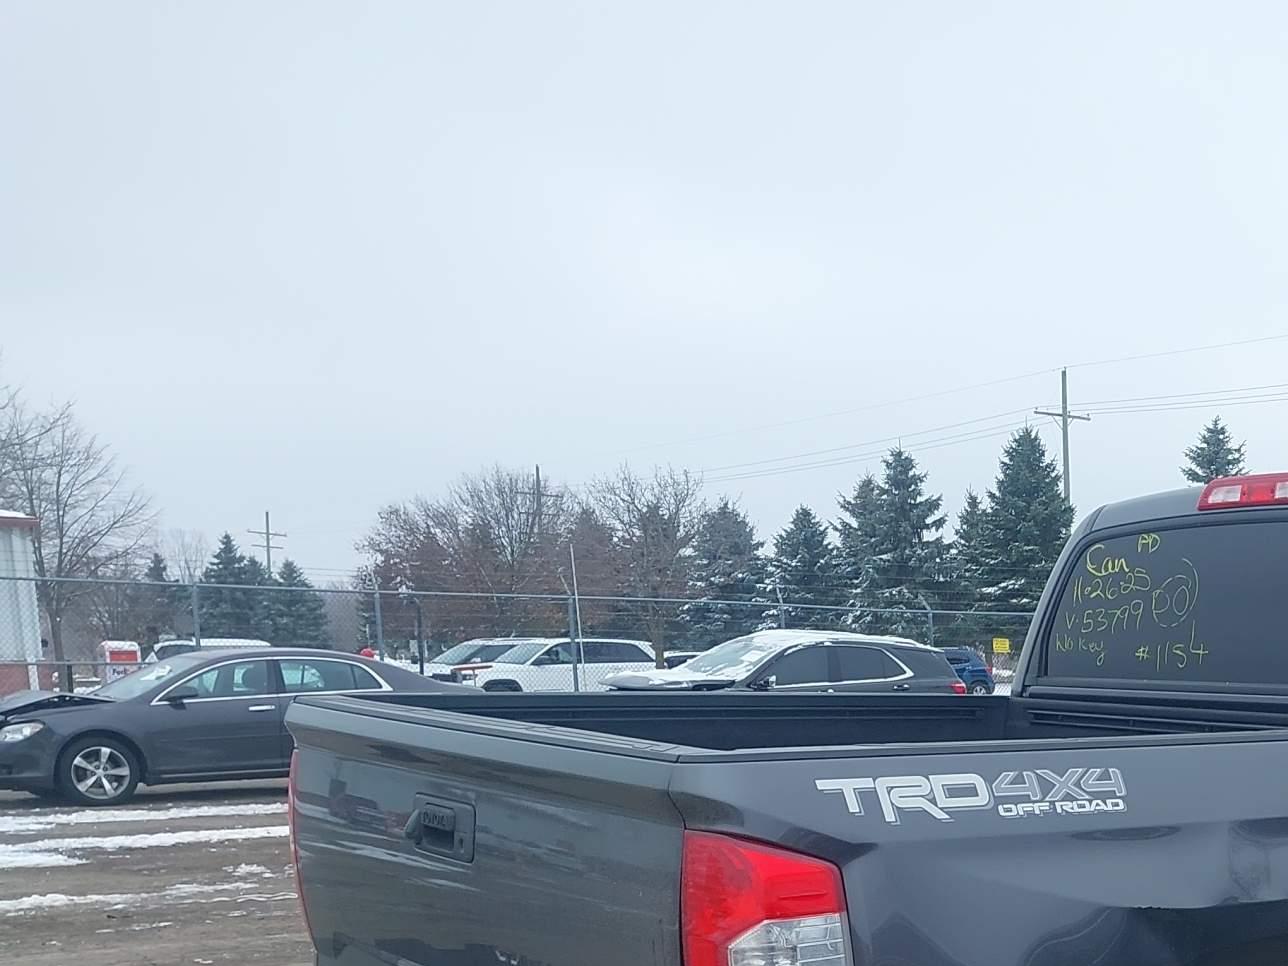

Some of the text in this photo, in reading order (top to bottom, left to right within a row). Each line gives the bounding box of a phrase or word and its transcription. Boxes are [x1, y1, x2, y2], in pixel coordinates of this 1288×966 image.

[814, 772, 995, 825] TRD
[997, 798, 1128, 819] OFF ROAD
